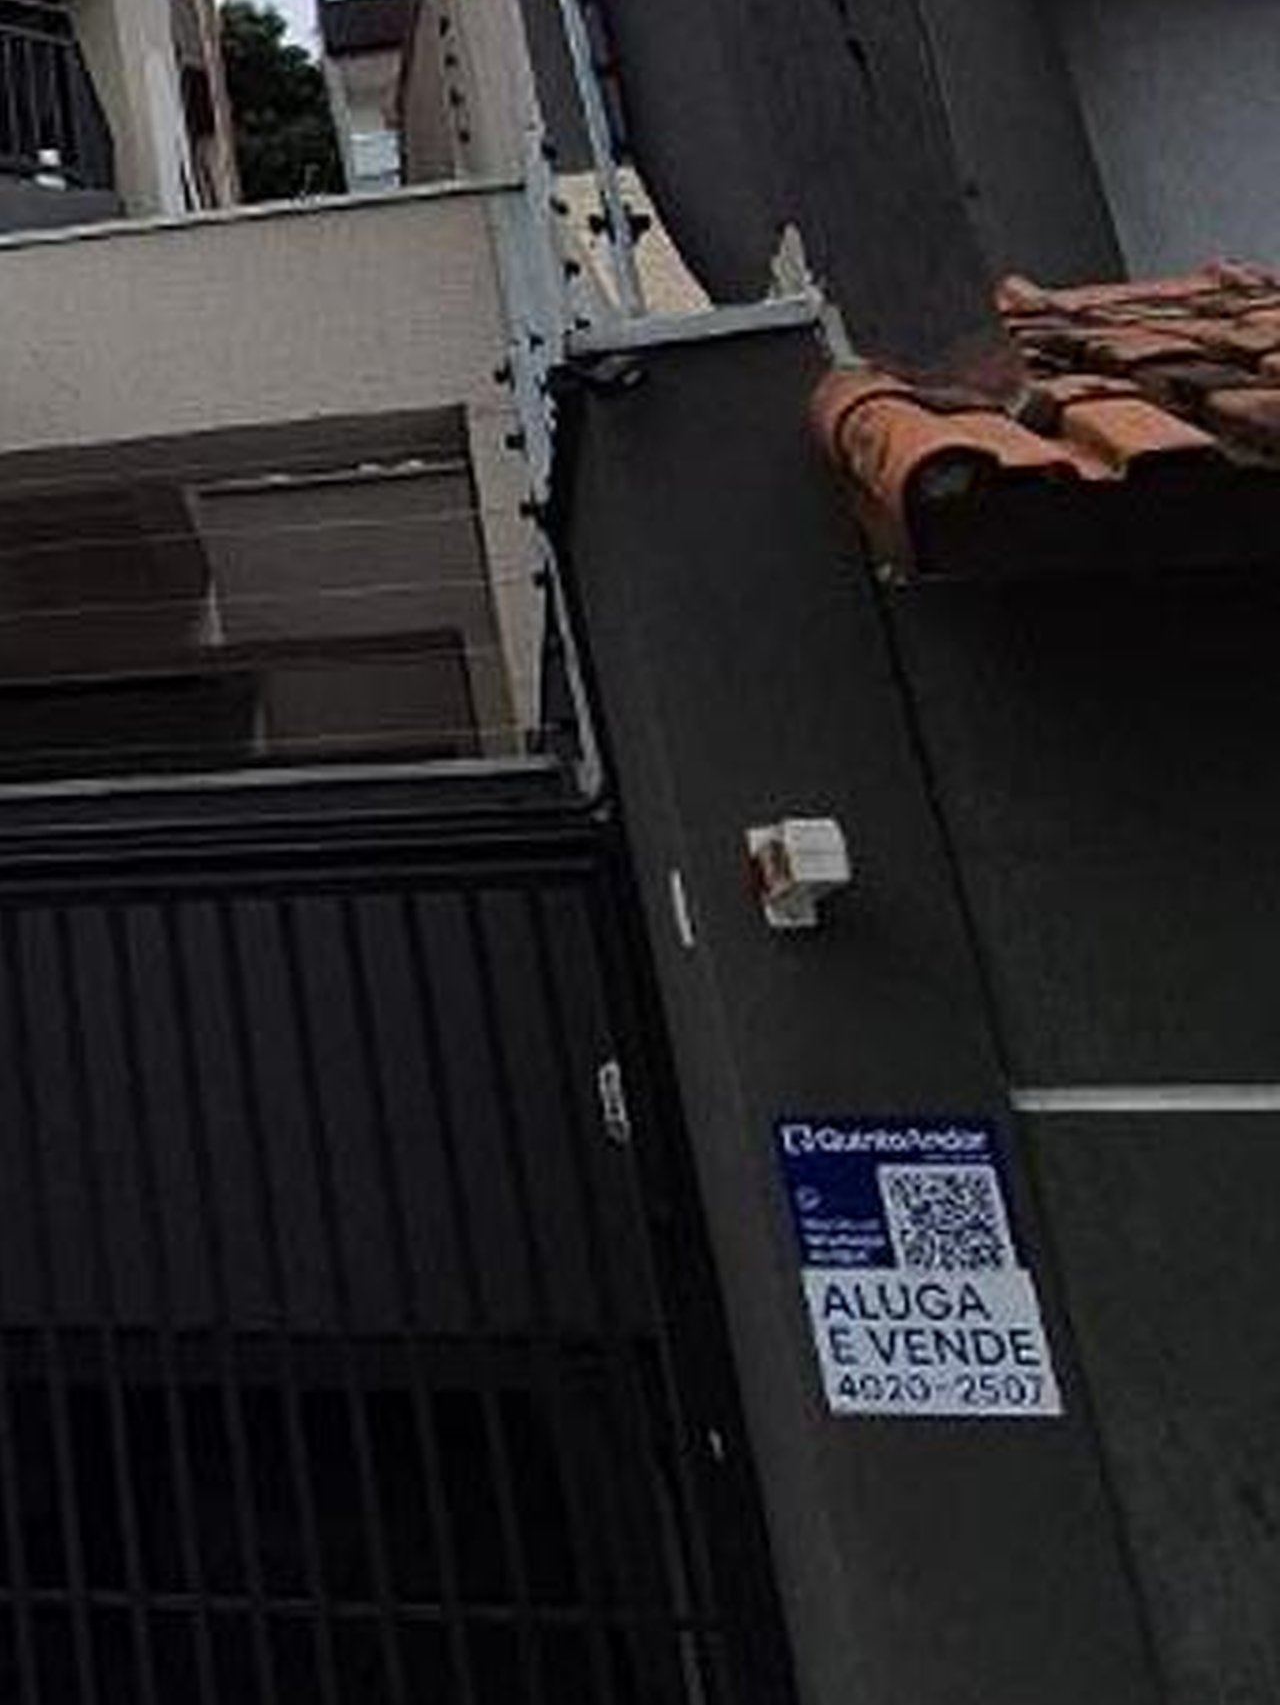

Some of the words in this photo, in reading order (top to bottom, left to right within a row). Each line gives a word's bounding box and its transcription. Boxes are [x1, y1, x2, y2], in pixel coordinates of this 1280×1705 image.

[824, 1283, 991, 1320] ALUGA
[829, 1327, 858, 1365] E
[865, 1328, 1041, 1366] VENDE
